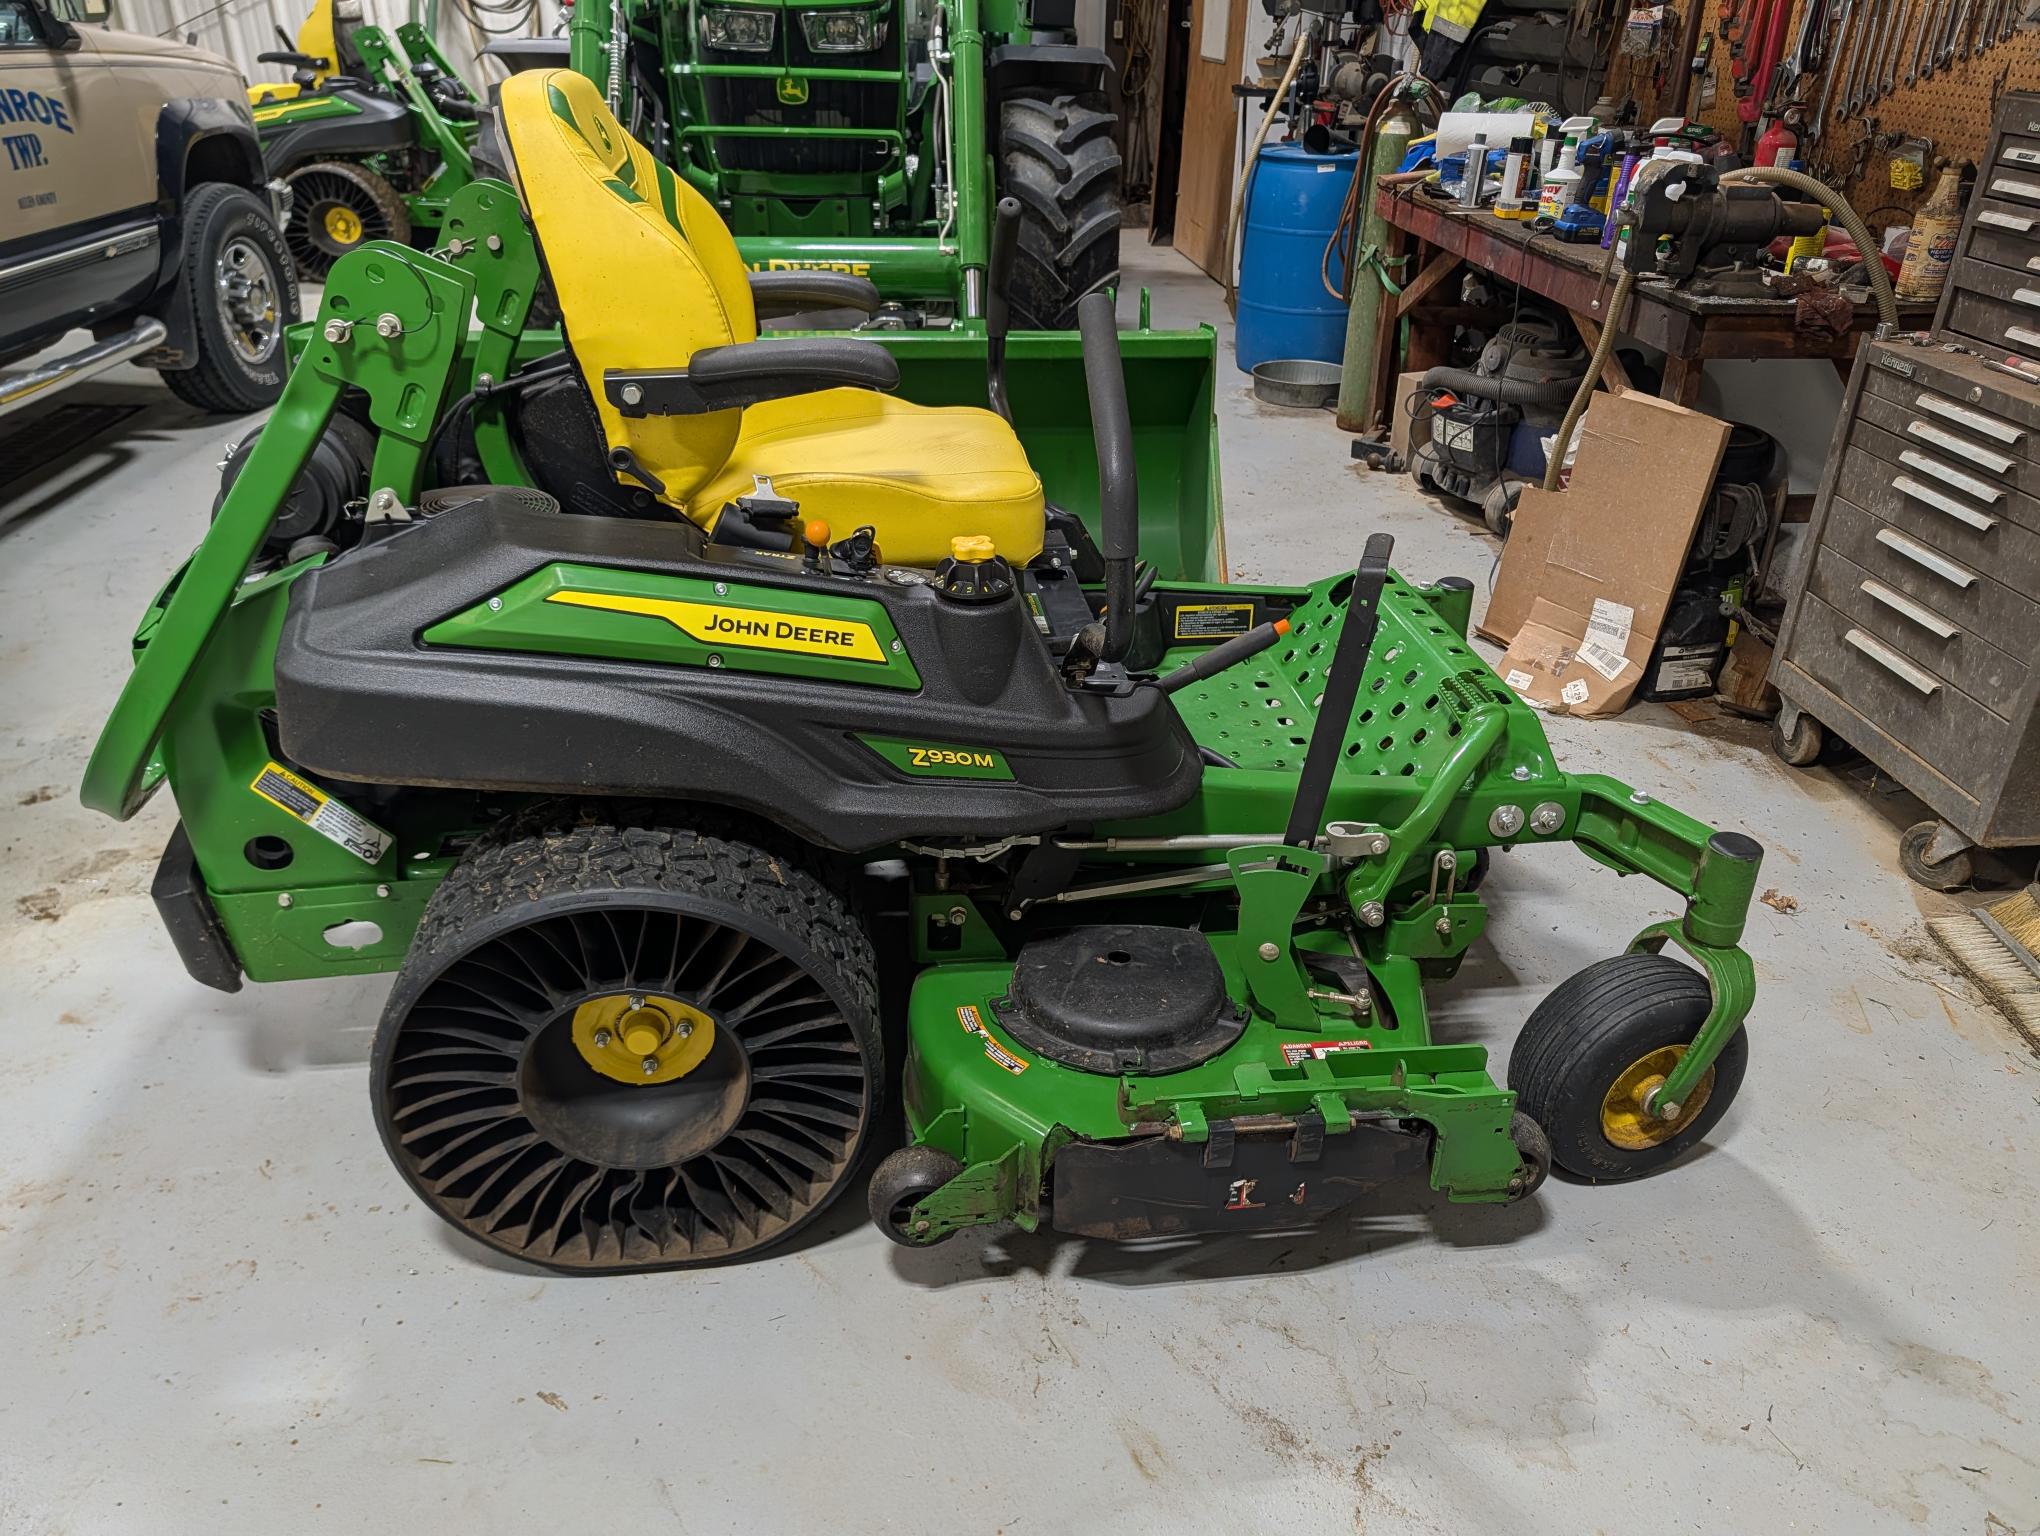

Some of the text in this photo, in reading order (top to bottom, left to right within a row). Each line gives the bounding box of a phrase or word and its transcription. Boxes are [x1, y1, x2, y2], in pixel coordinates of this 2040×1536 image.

[0, 88, 74, 134] NROE
[2, 133, 48, 170] TWP.
[1881, 351, 1914, 377] Kennedy
[704, 614, 855, 647] JOHN DEERE
[907, 747, 994, 768] Z930M
[286, 772, 315, 795] CAUTION
